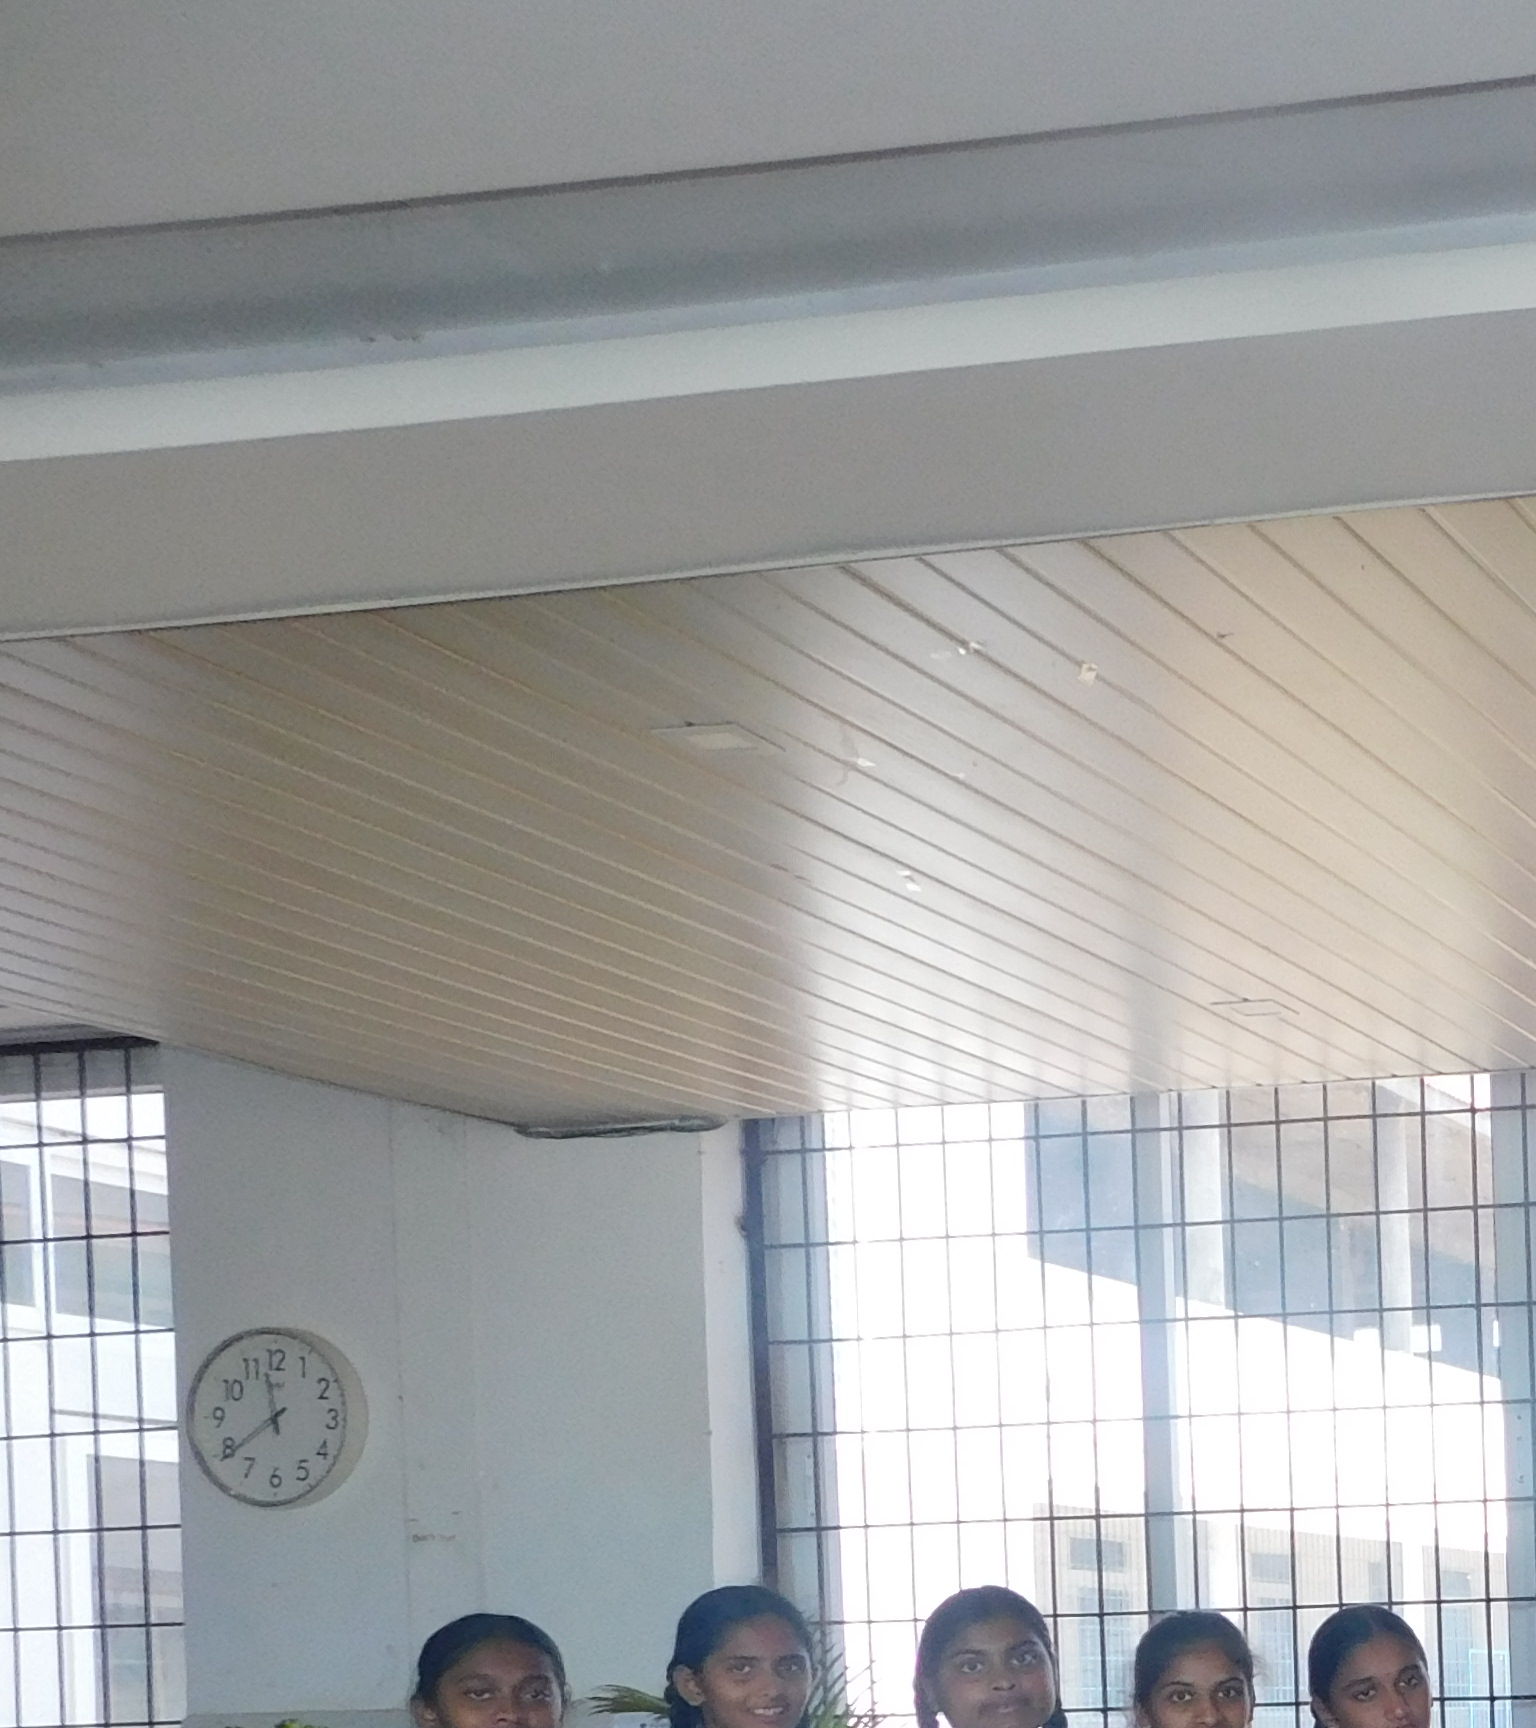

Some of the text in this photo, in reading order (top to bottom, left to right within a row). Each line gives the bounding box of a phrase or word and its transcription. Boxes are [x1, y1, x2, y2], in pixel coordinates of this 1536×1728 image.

[243, 1358, 260, 1380] 11
[267, 1349, 286, 1371] 12
[299, 1357, 306, 1378] 1
[222, 1379, 244, 1401] 10
[317, 1378, 330, 1400] 2
[213, 1406, 226, 1428] 9
[325, 1408, 339, 1430] 3
[222, 1437, 236, 1459] 8
[316, 1439, 329, 1460] 4
[244, 1457, 256, 1479] 7
[269, 1467, 282, 1488] 6
[296, 1459, 310, 1481] 5
